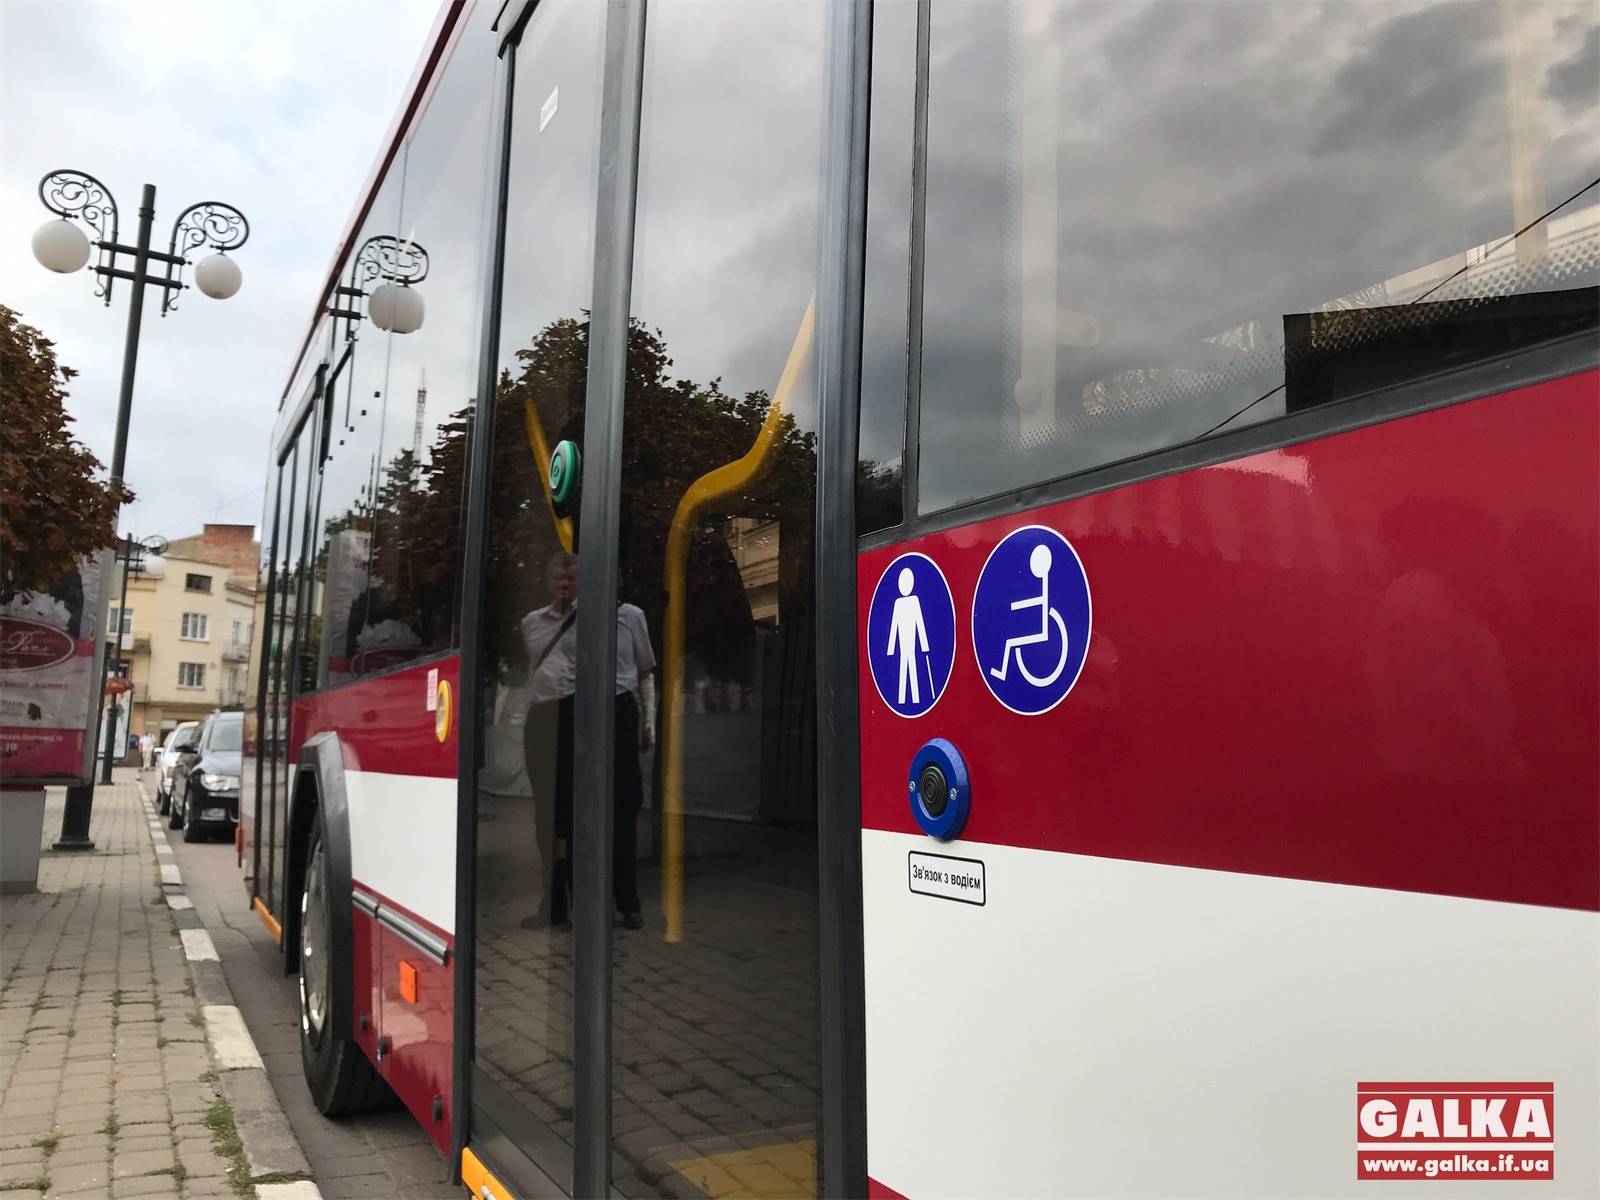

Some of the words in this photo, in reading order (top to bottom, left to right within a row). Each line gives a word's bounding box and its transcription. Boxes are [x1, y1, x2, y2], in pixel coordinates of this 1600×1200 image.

[912, 864, 943, 883] Зв'язок
[944, 873, 949, 884] з
[951, 873, 981, 890] водієм
